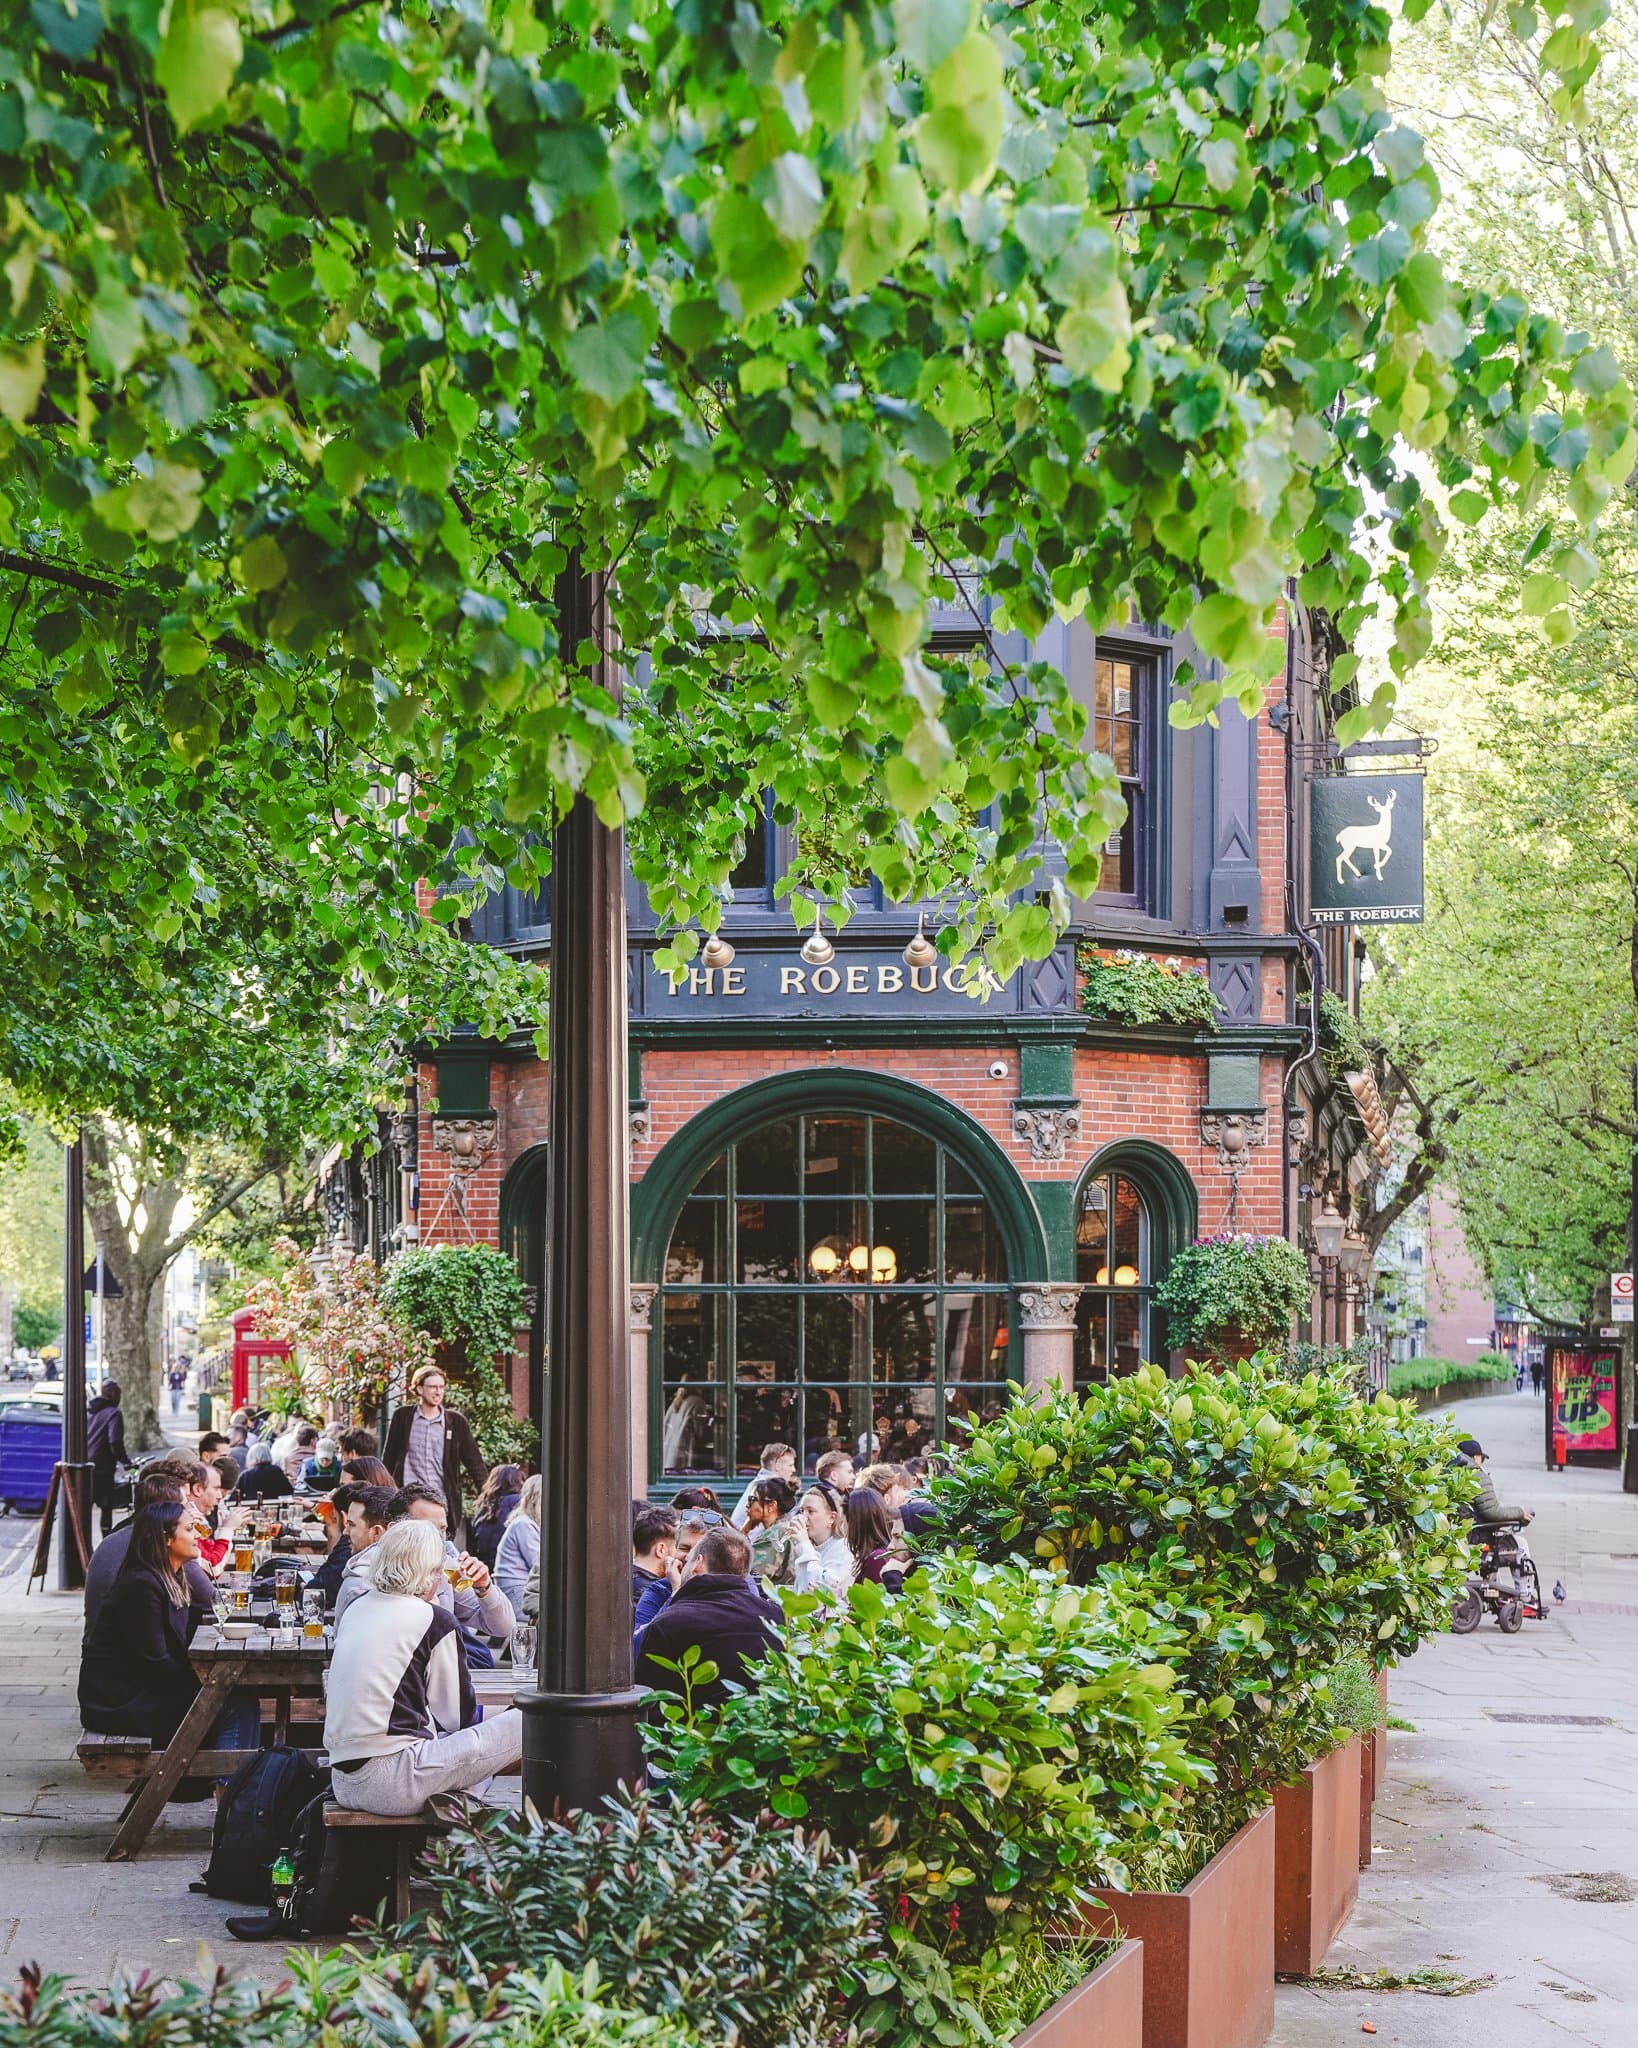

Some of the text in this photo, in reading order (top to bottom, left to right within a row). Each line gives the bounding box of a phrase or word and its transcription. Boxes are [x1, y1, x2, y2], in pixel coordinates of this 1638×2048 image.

[1312, 908, 1420, 921] THE ROEBUCK
[660, 967, 747, 995] THE
[1564, 1387, 1581, 1400] IT
[1558, 1402, 1599, 1422] UP
